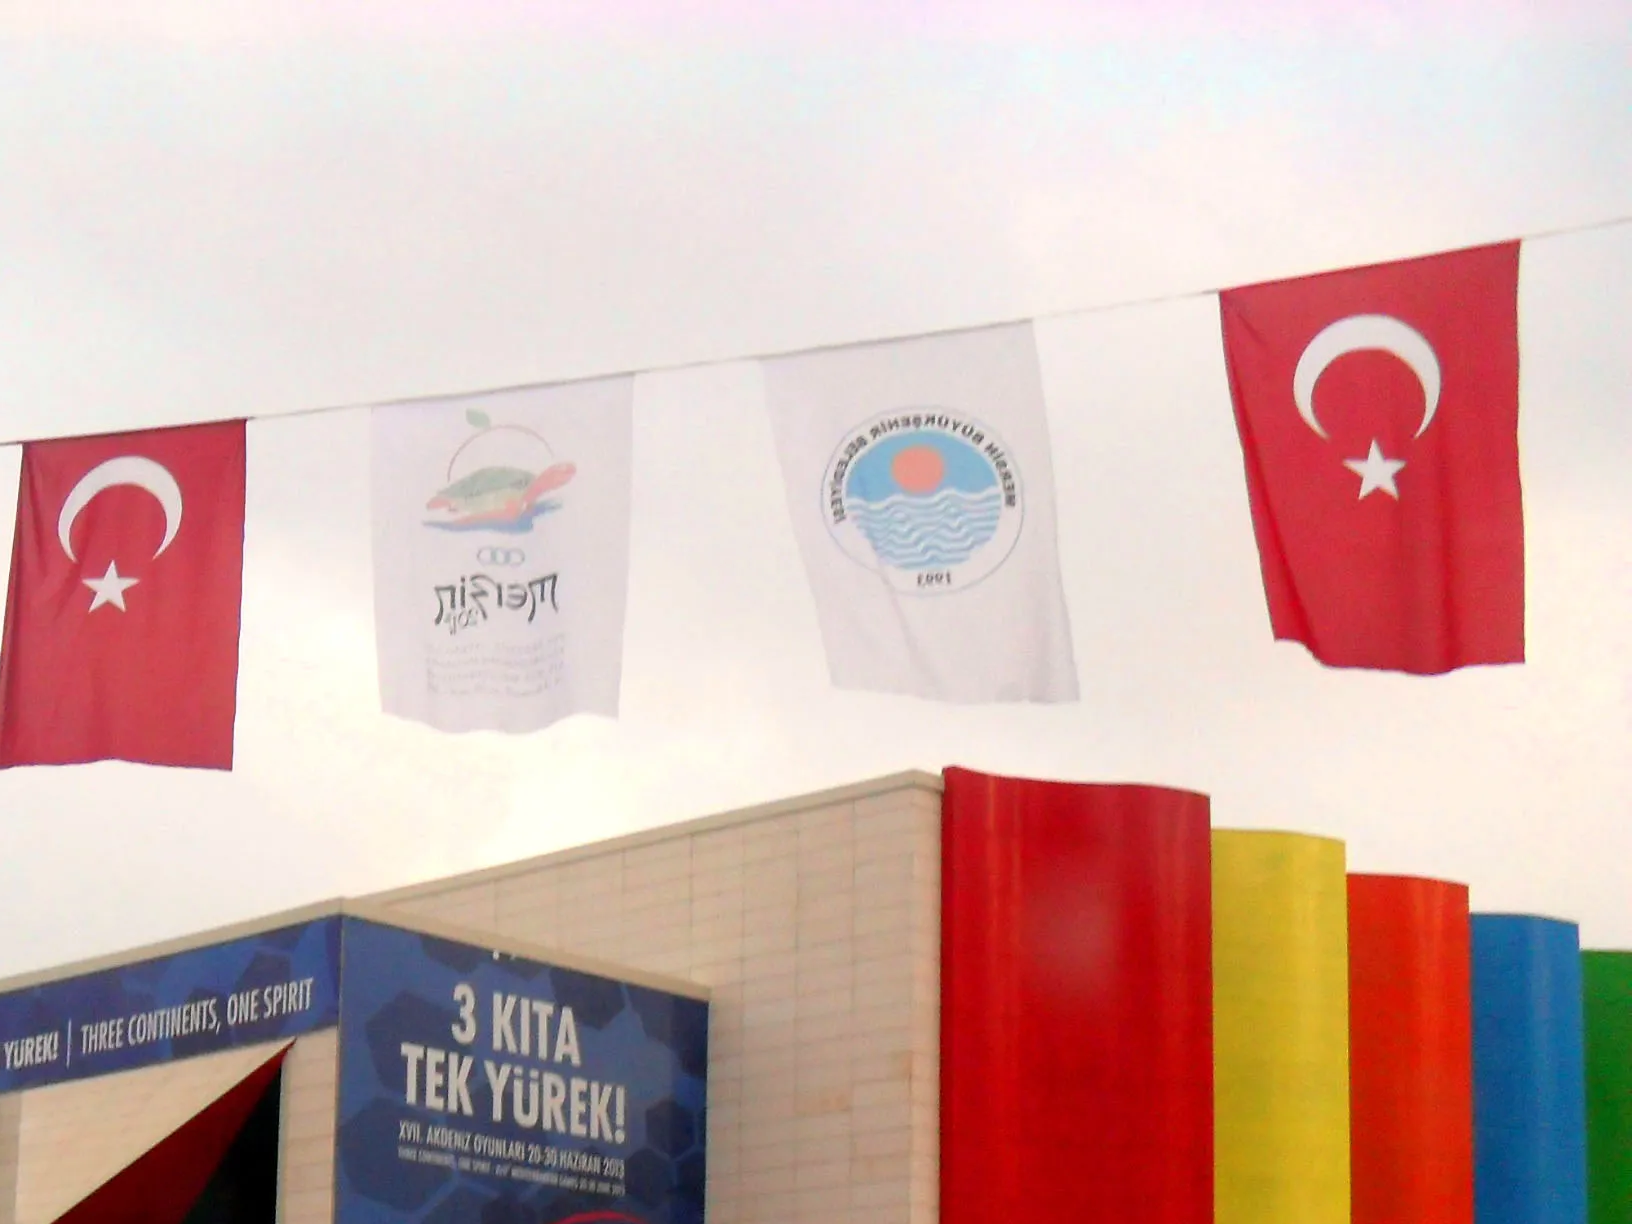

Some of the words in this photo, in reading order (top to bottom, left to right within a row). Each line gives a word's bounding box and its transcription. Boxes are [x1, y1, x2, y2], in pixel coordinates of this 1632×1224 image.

[80, 1017, 125, 1055] THREE
[127, 997, 220, 1044] CONTINENTS,
[227, 988, 260, 1026] ONE
[263, 977, 315, 1016] SPIRIT
[451, 983, 476, 1045] 3
[492, 991, 581, 1068] KITA
[400, 1042, 474, 1117] TEK
[484, 1059, 626, 1144] YÜREK!
